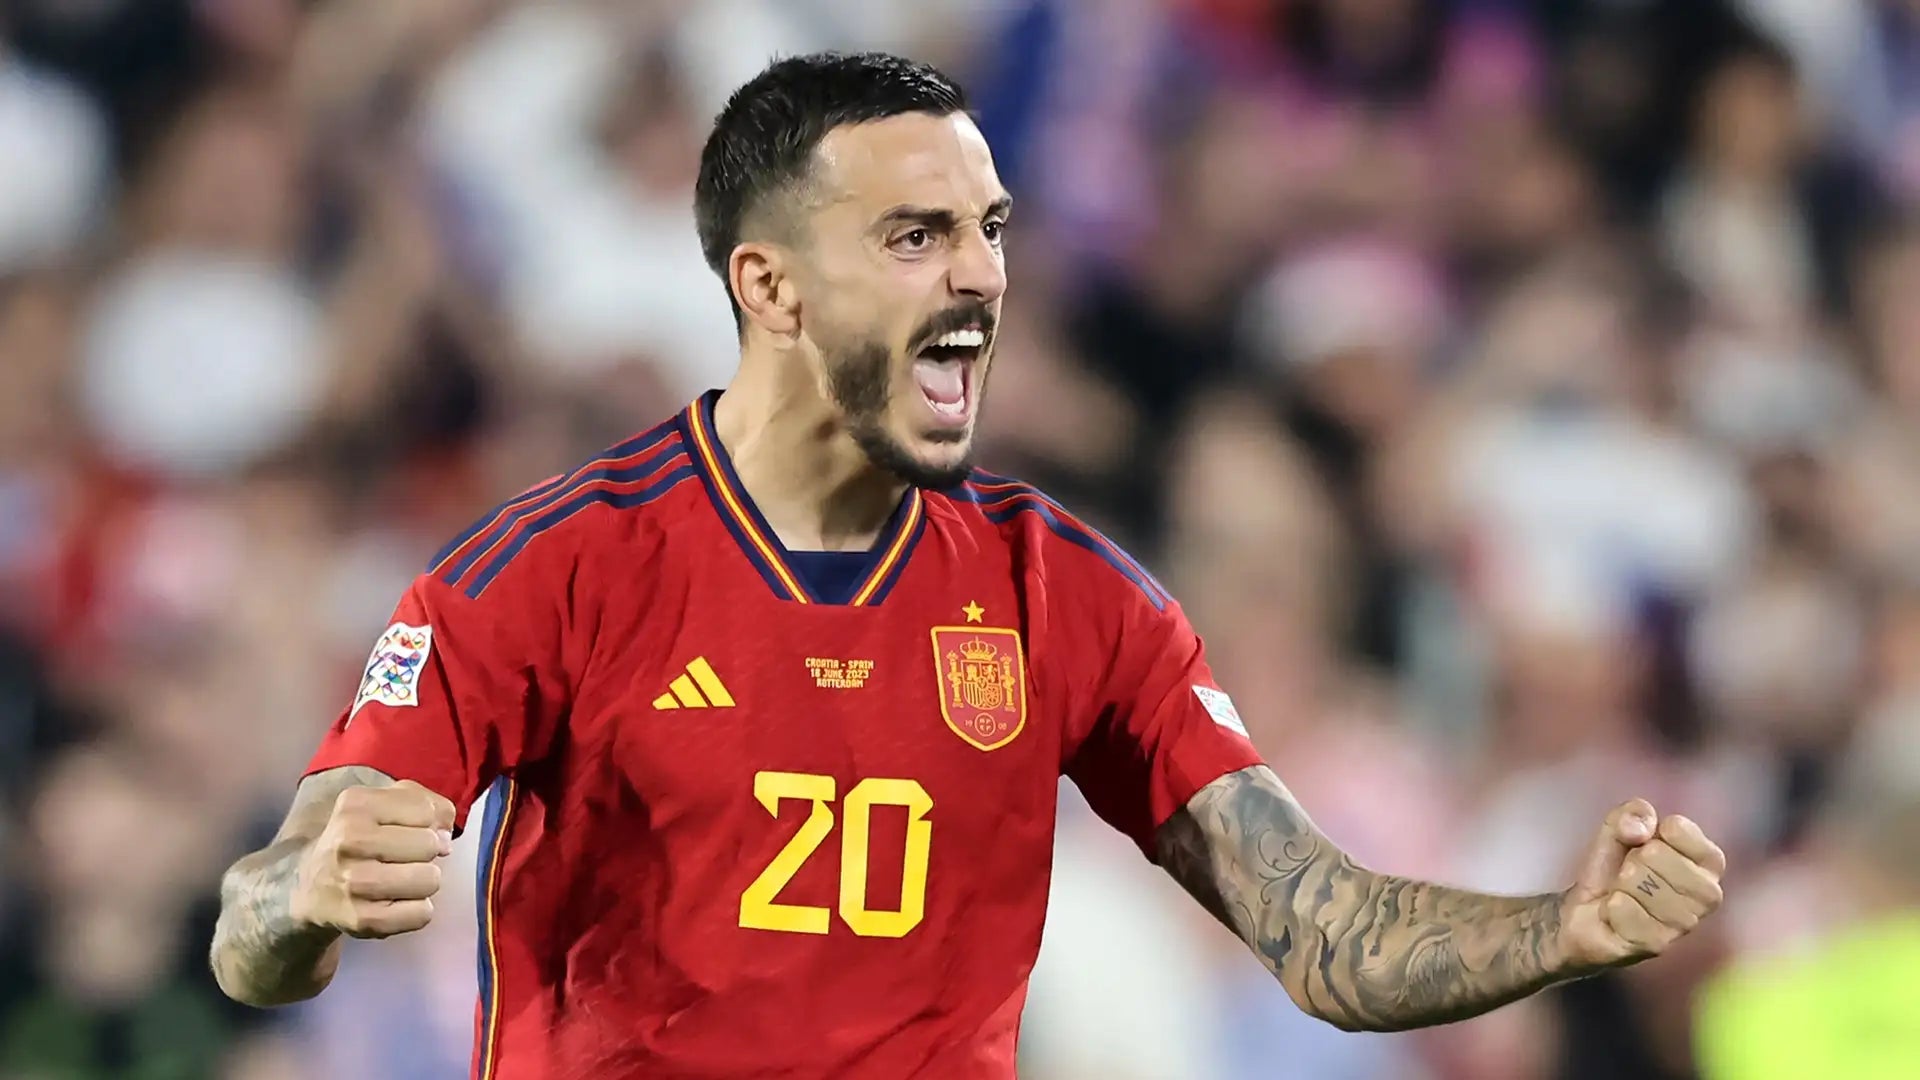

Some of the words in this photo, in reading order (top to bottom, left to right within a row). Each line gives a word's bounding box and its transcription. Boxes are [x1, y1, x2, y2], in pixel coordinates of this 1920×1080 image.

[805, 657, 839, 669] CROATIA
[848, 660, 874, 669] SPAIN
[811, 668, 821, 678] 18
[823, 669, 844, 679] JUNE
[845, 669, 869, 679] 2023
[816, 678, 864, 688] ROTTERDAM
[739, 771, 934, 938] 20
